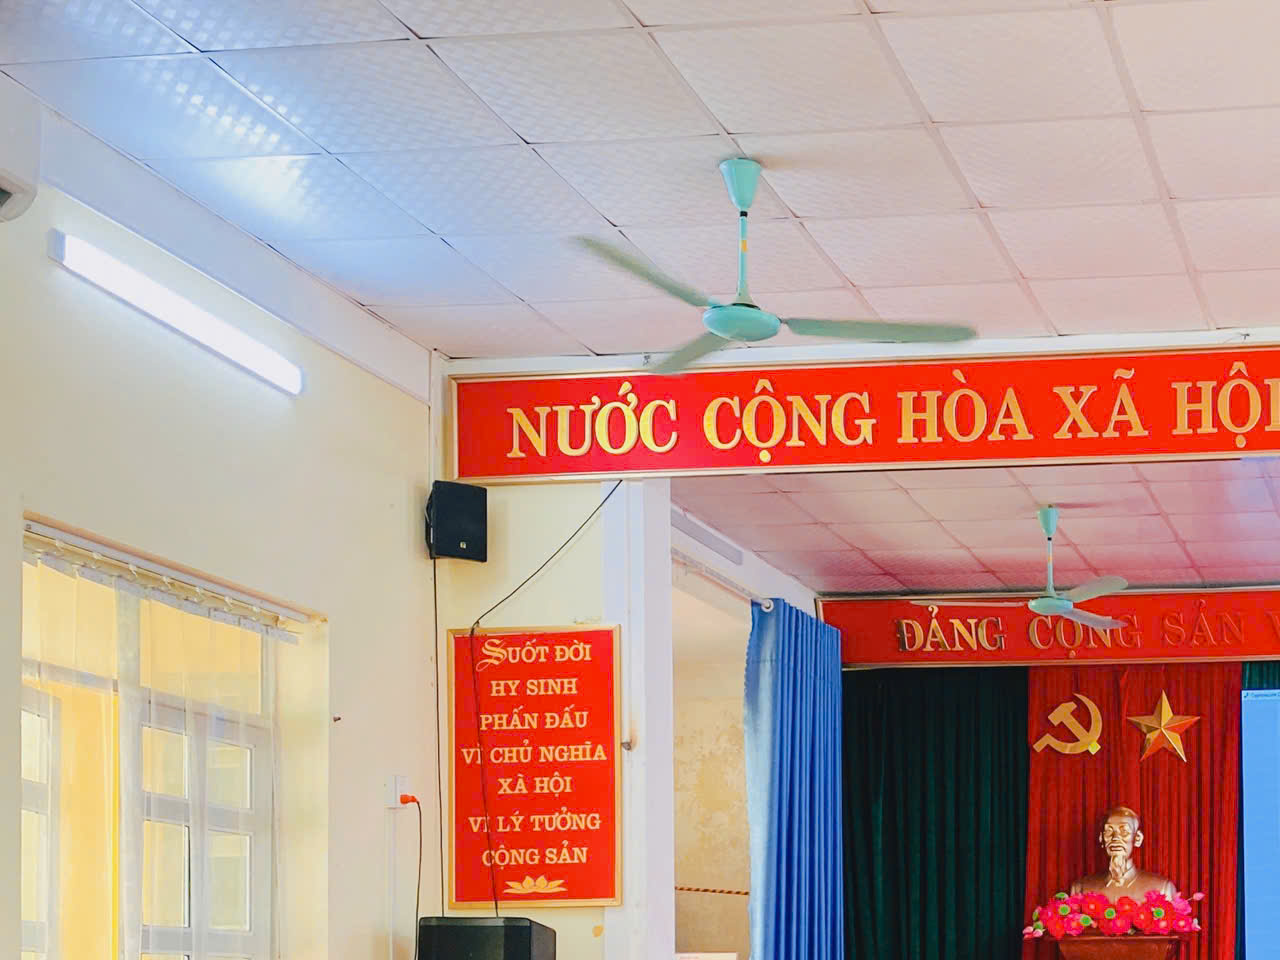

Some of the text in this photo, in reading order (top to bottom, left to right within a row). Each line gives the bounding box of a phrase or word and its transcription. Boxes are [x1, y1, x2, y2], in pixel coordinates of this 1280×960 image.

[507, 381, 678, 458] NƯỚC
[702, 378, 877, 463] CỘNG
[896, 369, 1034, 444] HÒA
[1052, 367, 1148, 439] XÃ
[896, 604, 1006, 653] ĐẢNG
[1159, 601, 1246, 649] SẢN
[475, 638, 592, 673] SUỐT ĐỜI
[490, 678, 578, 696] HY SINH
[480, 704, 589, 730] PHẤN ĐẤU
[490, 739, 533, 763] CHỦ
[538, 742, 607, 762] NGHĨA
[534, 772, 573, 797] HỘI
[497, 810, 525, 832] LÝ
[530, 807, 602, 831] TƯỞNG
[481, 840, 588, 870] CỘNG SẢN
